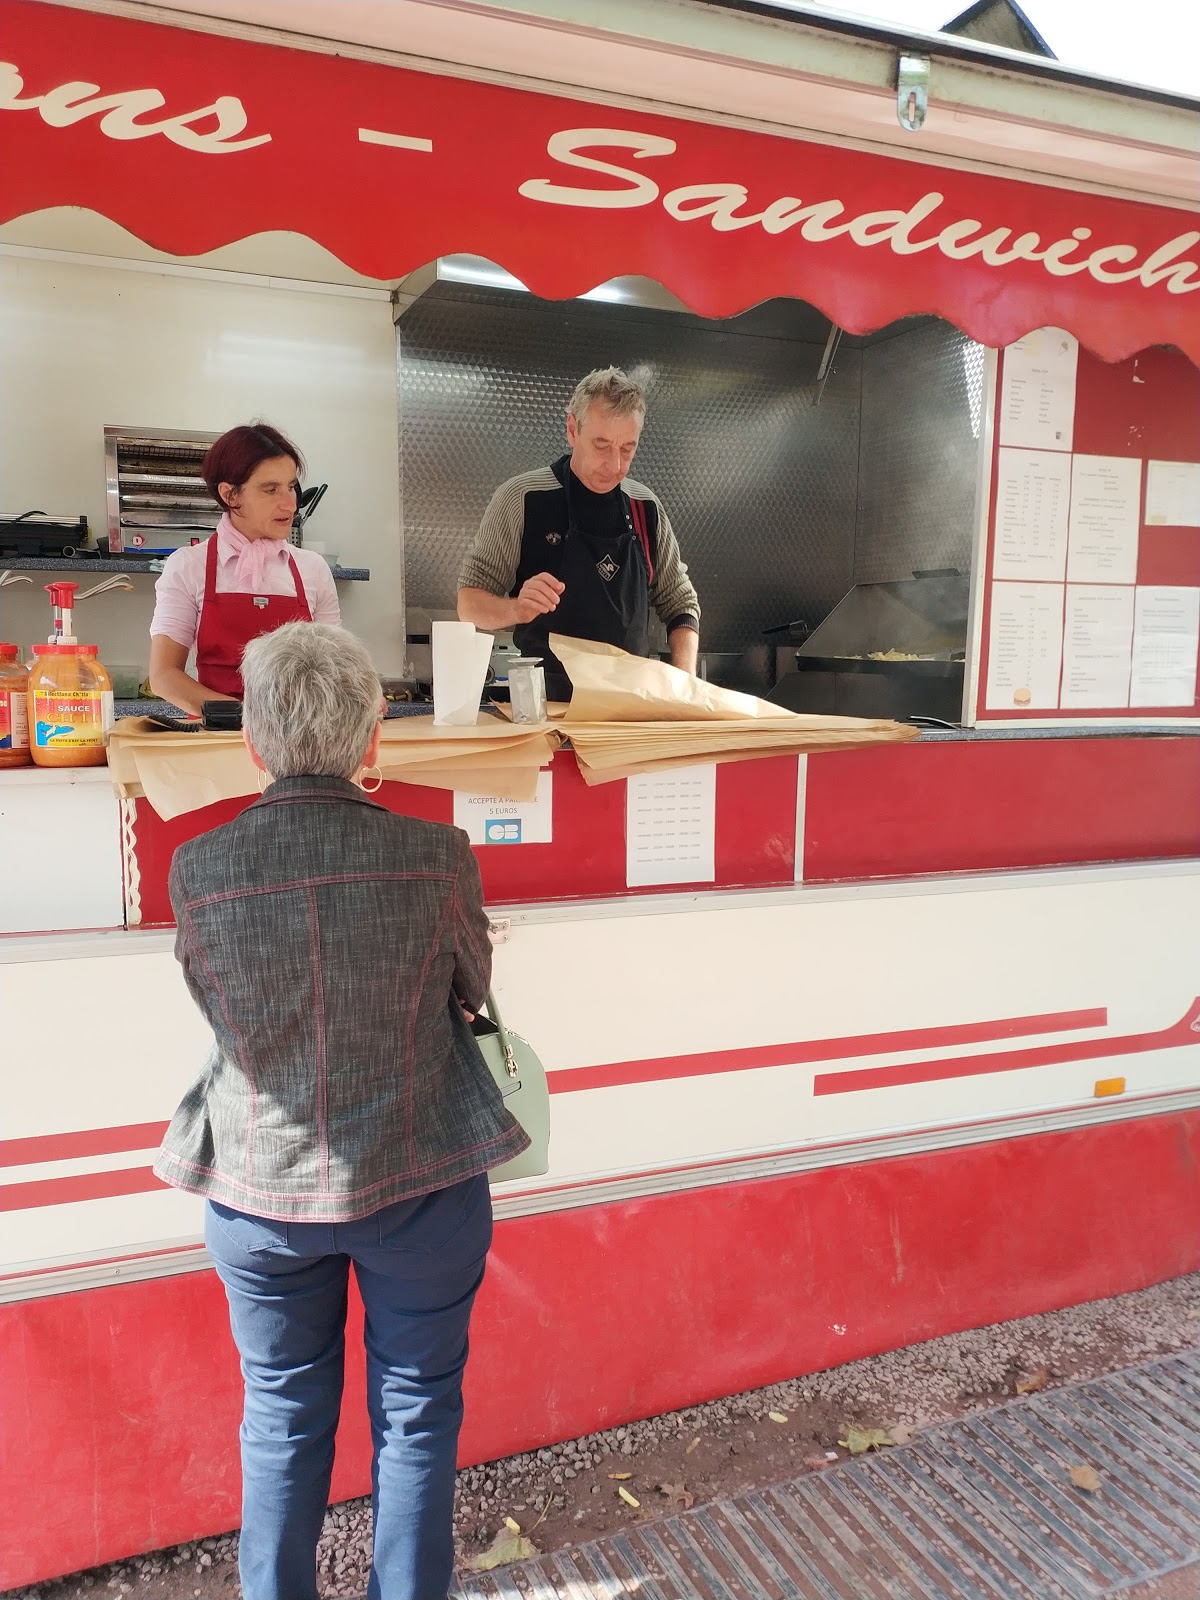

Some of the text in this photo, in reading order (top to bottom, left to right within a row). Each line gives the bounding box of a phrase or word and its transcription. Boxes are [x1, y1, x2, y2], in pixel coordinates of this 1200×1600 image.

[518, 128, 1200, 294] Sandwich
[468, 797, 497, 805] ACCEPTE
[495, 807, 518, 815] EUROS
[488, 824, 519, 840] CB
